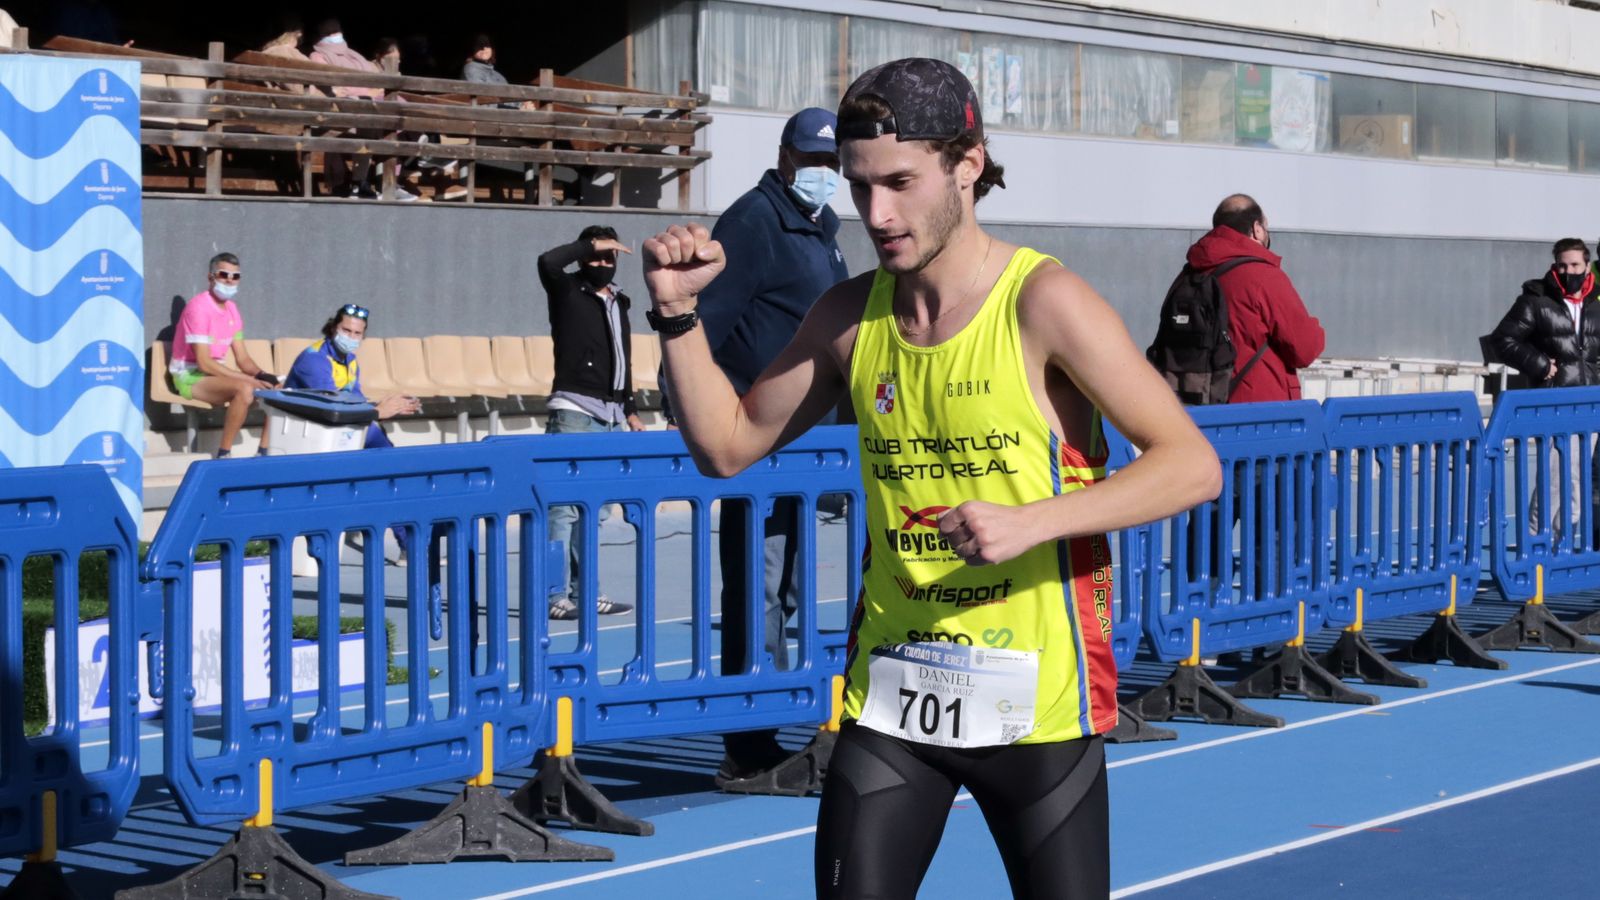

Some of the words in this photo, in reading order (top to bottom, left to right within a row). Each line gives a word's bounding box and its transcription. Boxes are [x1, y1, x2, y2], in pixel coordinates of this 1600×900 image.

[947, 379, 991, 398] GOBIK
[908, 428, 1020, 455] TRIATLÓN
[952, 459, 1019, 479] REAL
[1093, 588, 1112, 643] REAL
[919, 666, 976, 688] DANIEL
[953, 686, 975, 698] RUIZ
[899, 687, 962, 739] 701
